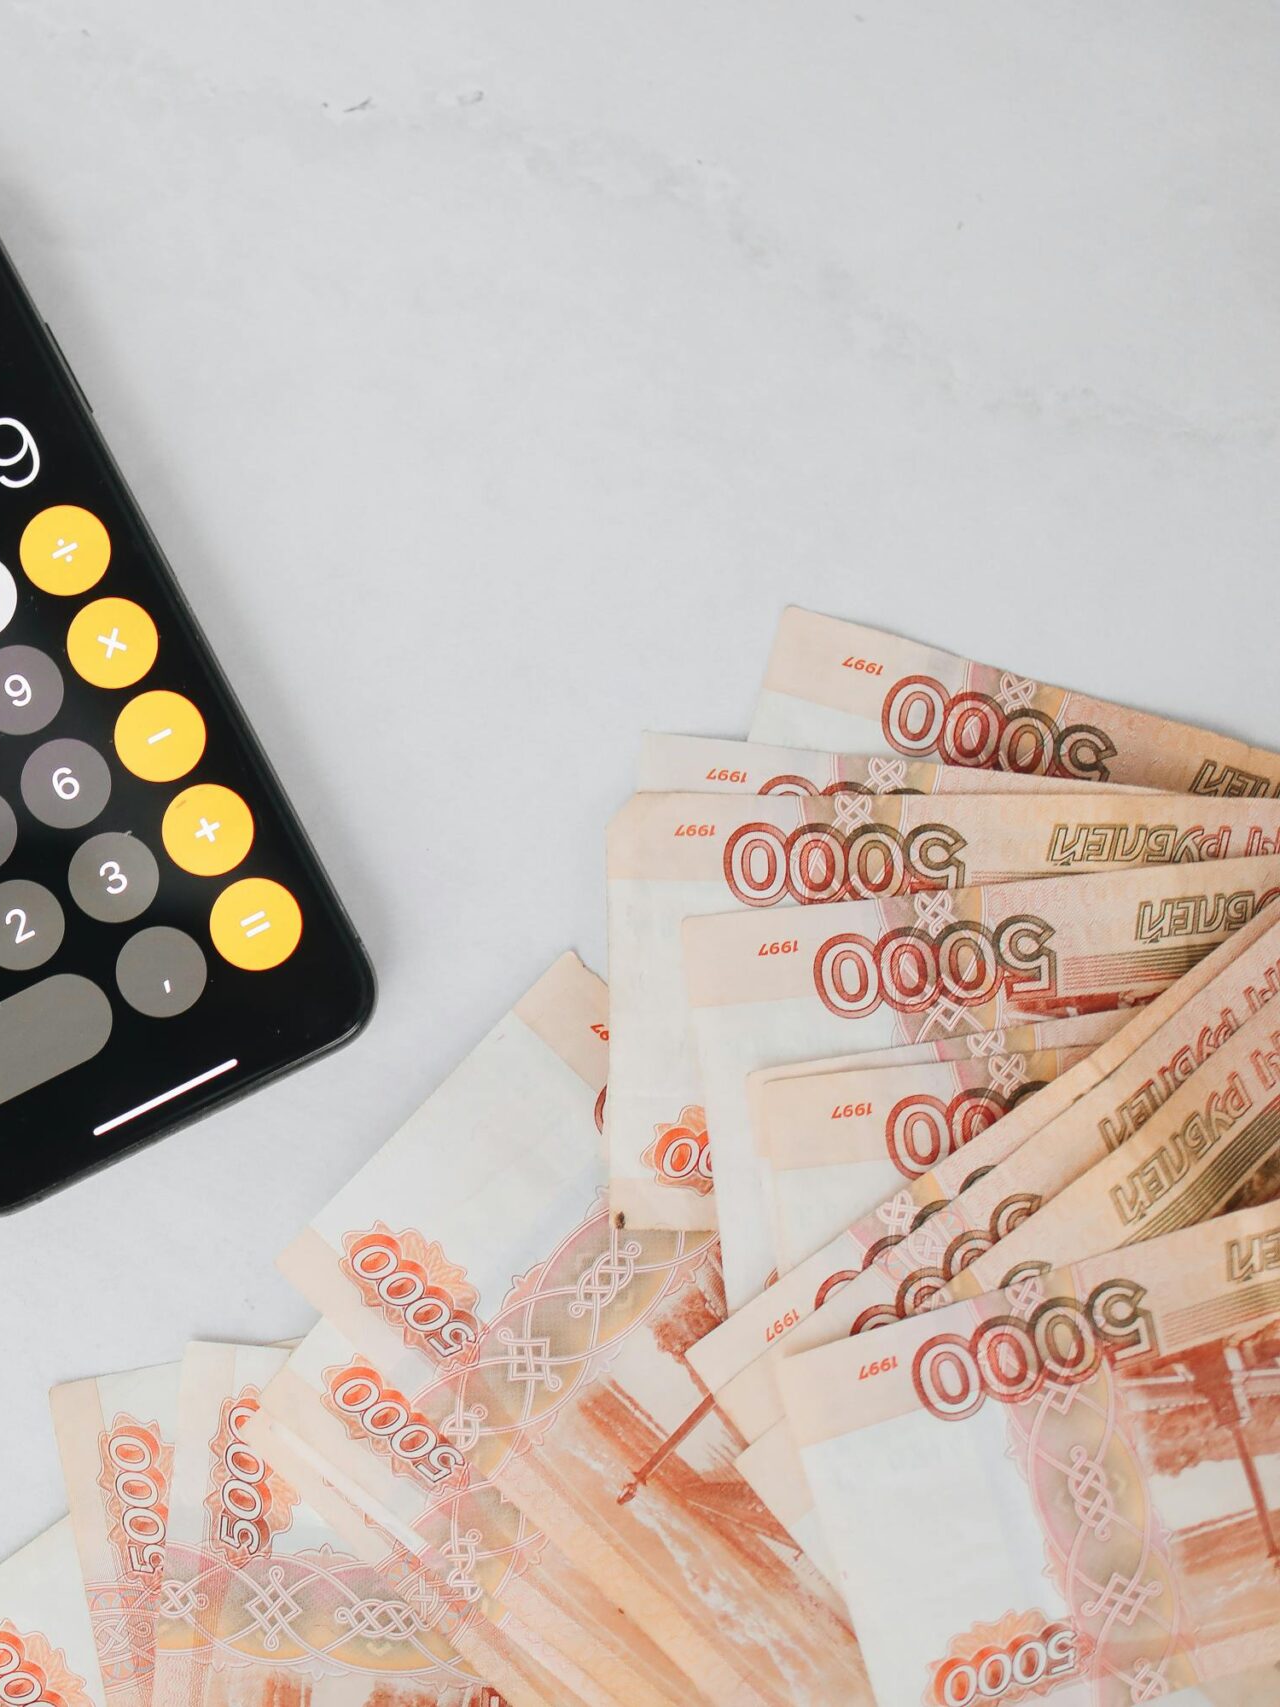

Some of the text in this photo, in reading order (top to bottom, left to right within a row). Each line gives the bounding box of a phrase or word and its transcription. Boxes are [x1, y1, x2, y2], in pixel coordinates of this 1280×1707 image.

[842, 655, 884, 677] 1997
[4, 674, 32, 707] 9
[881, 674, 1118, 783] 5000
[52, 766, 81, 801] 6
[705, 767, 747, 784] 1997
[673, 823, 716, 838] 1997
[1045, 823, 1233, 867] РУБЛЕЙ
[99, 860, 128, 895] 3
[723, 821, 969, 908] 5000
[5, 908, 36, 944] 2
[757, 939, 799, 957] 1997
[813, 913, 1058, 1019] 5000
[831, 1102, 873, 1120] 1997
[1108, 1070, 1254, 1226] РУБЛЕЙ
[352, 1244, 477, 1358] 5000
[765, 1308, 801, 1343] 1997
[911, 1277, 1161, 1422] 5000
[858, 1355, 899, 1381] 1997
[333, 1377, 466, 1484] 5000
[108, 1434, 167, 1574] 5000
[940, 1629, 1079, 1707] 5000
